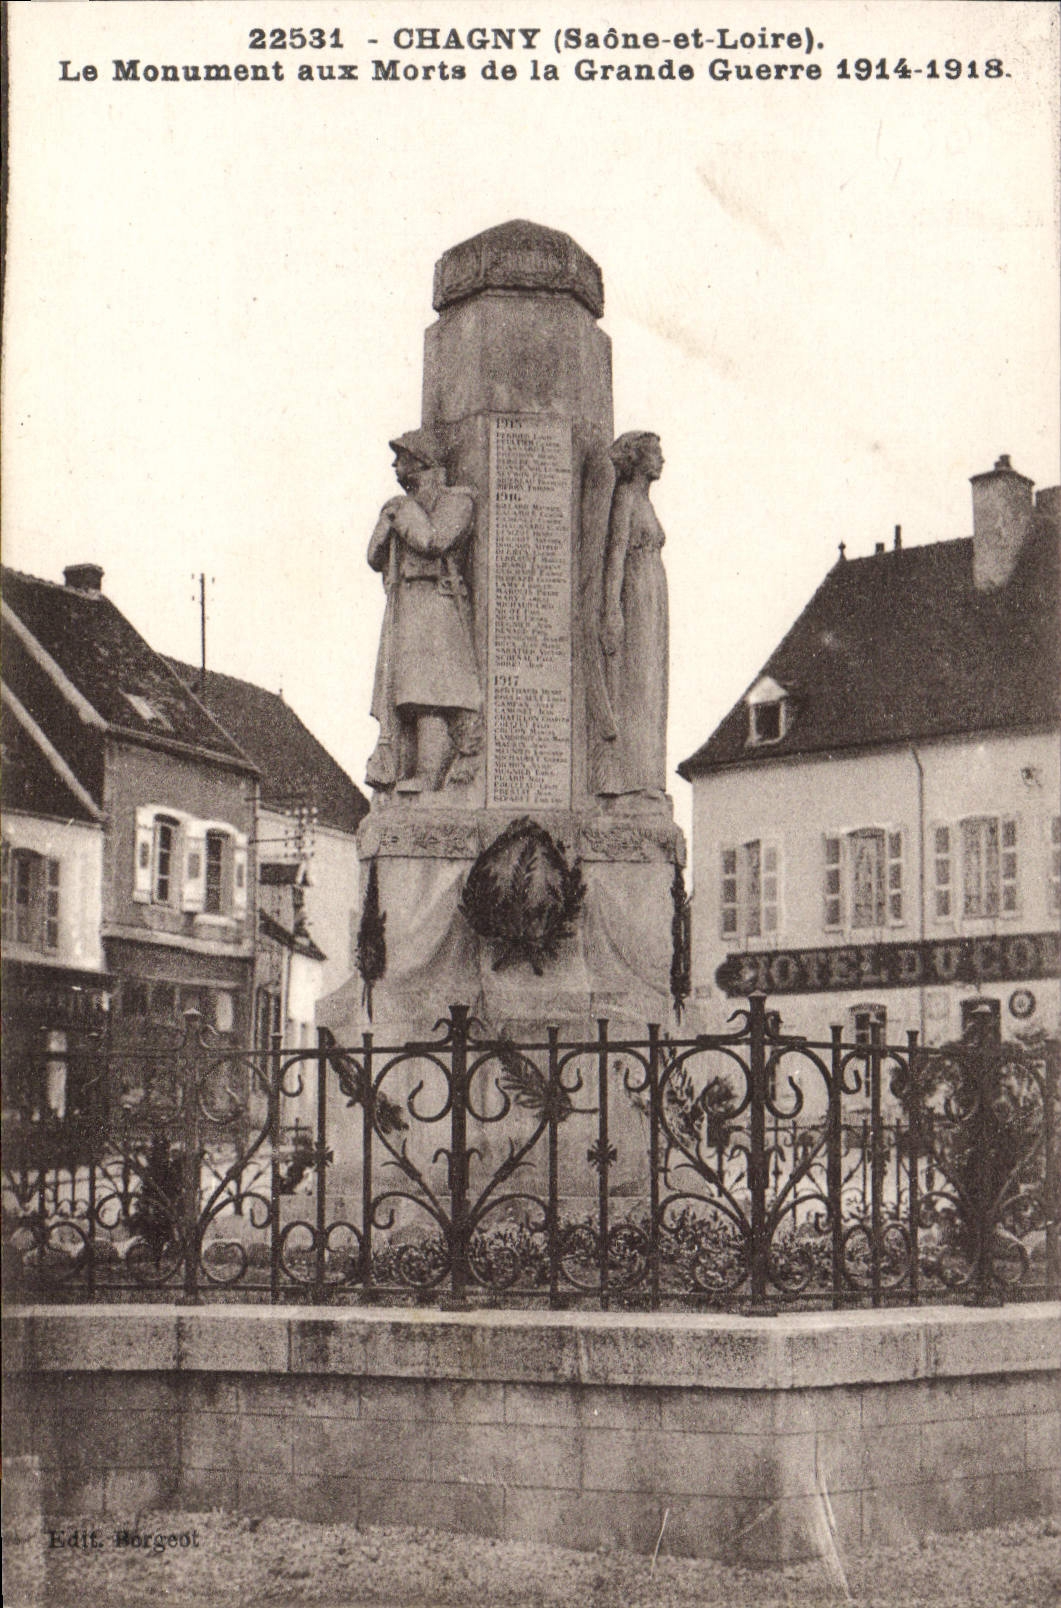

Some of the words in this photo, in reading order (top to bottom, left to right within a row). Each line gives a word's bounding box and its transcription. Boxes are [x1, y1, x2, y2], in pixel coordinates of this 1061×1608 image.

[495, 492, 522, 502] 1916
[494, 675, 520, 686] 1917
[899, 947, 961, 981] DU
